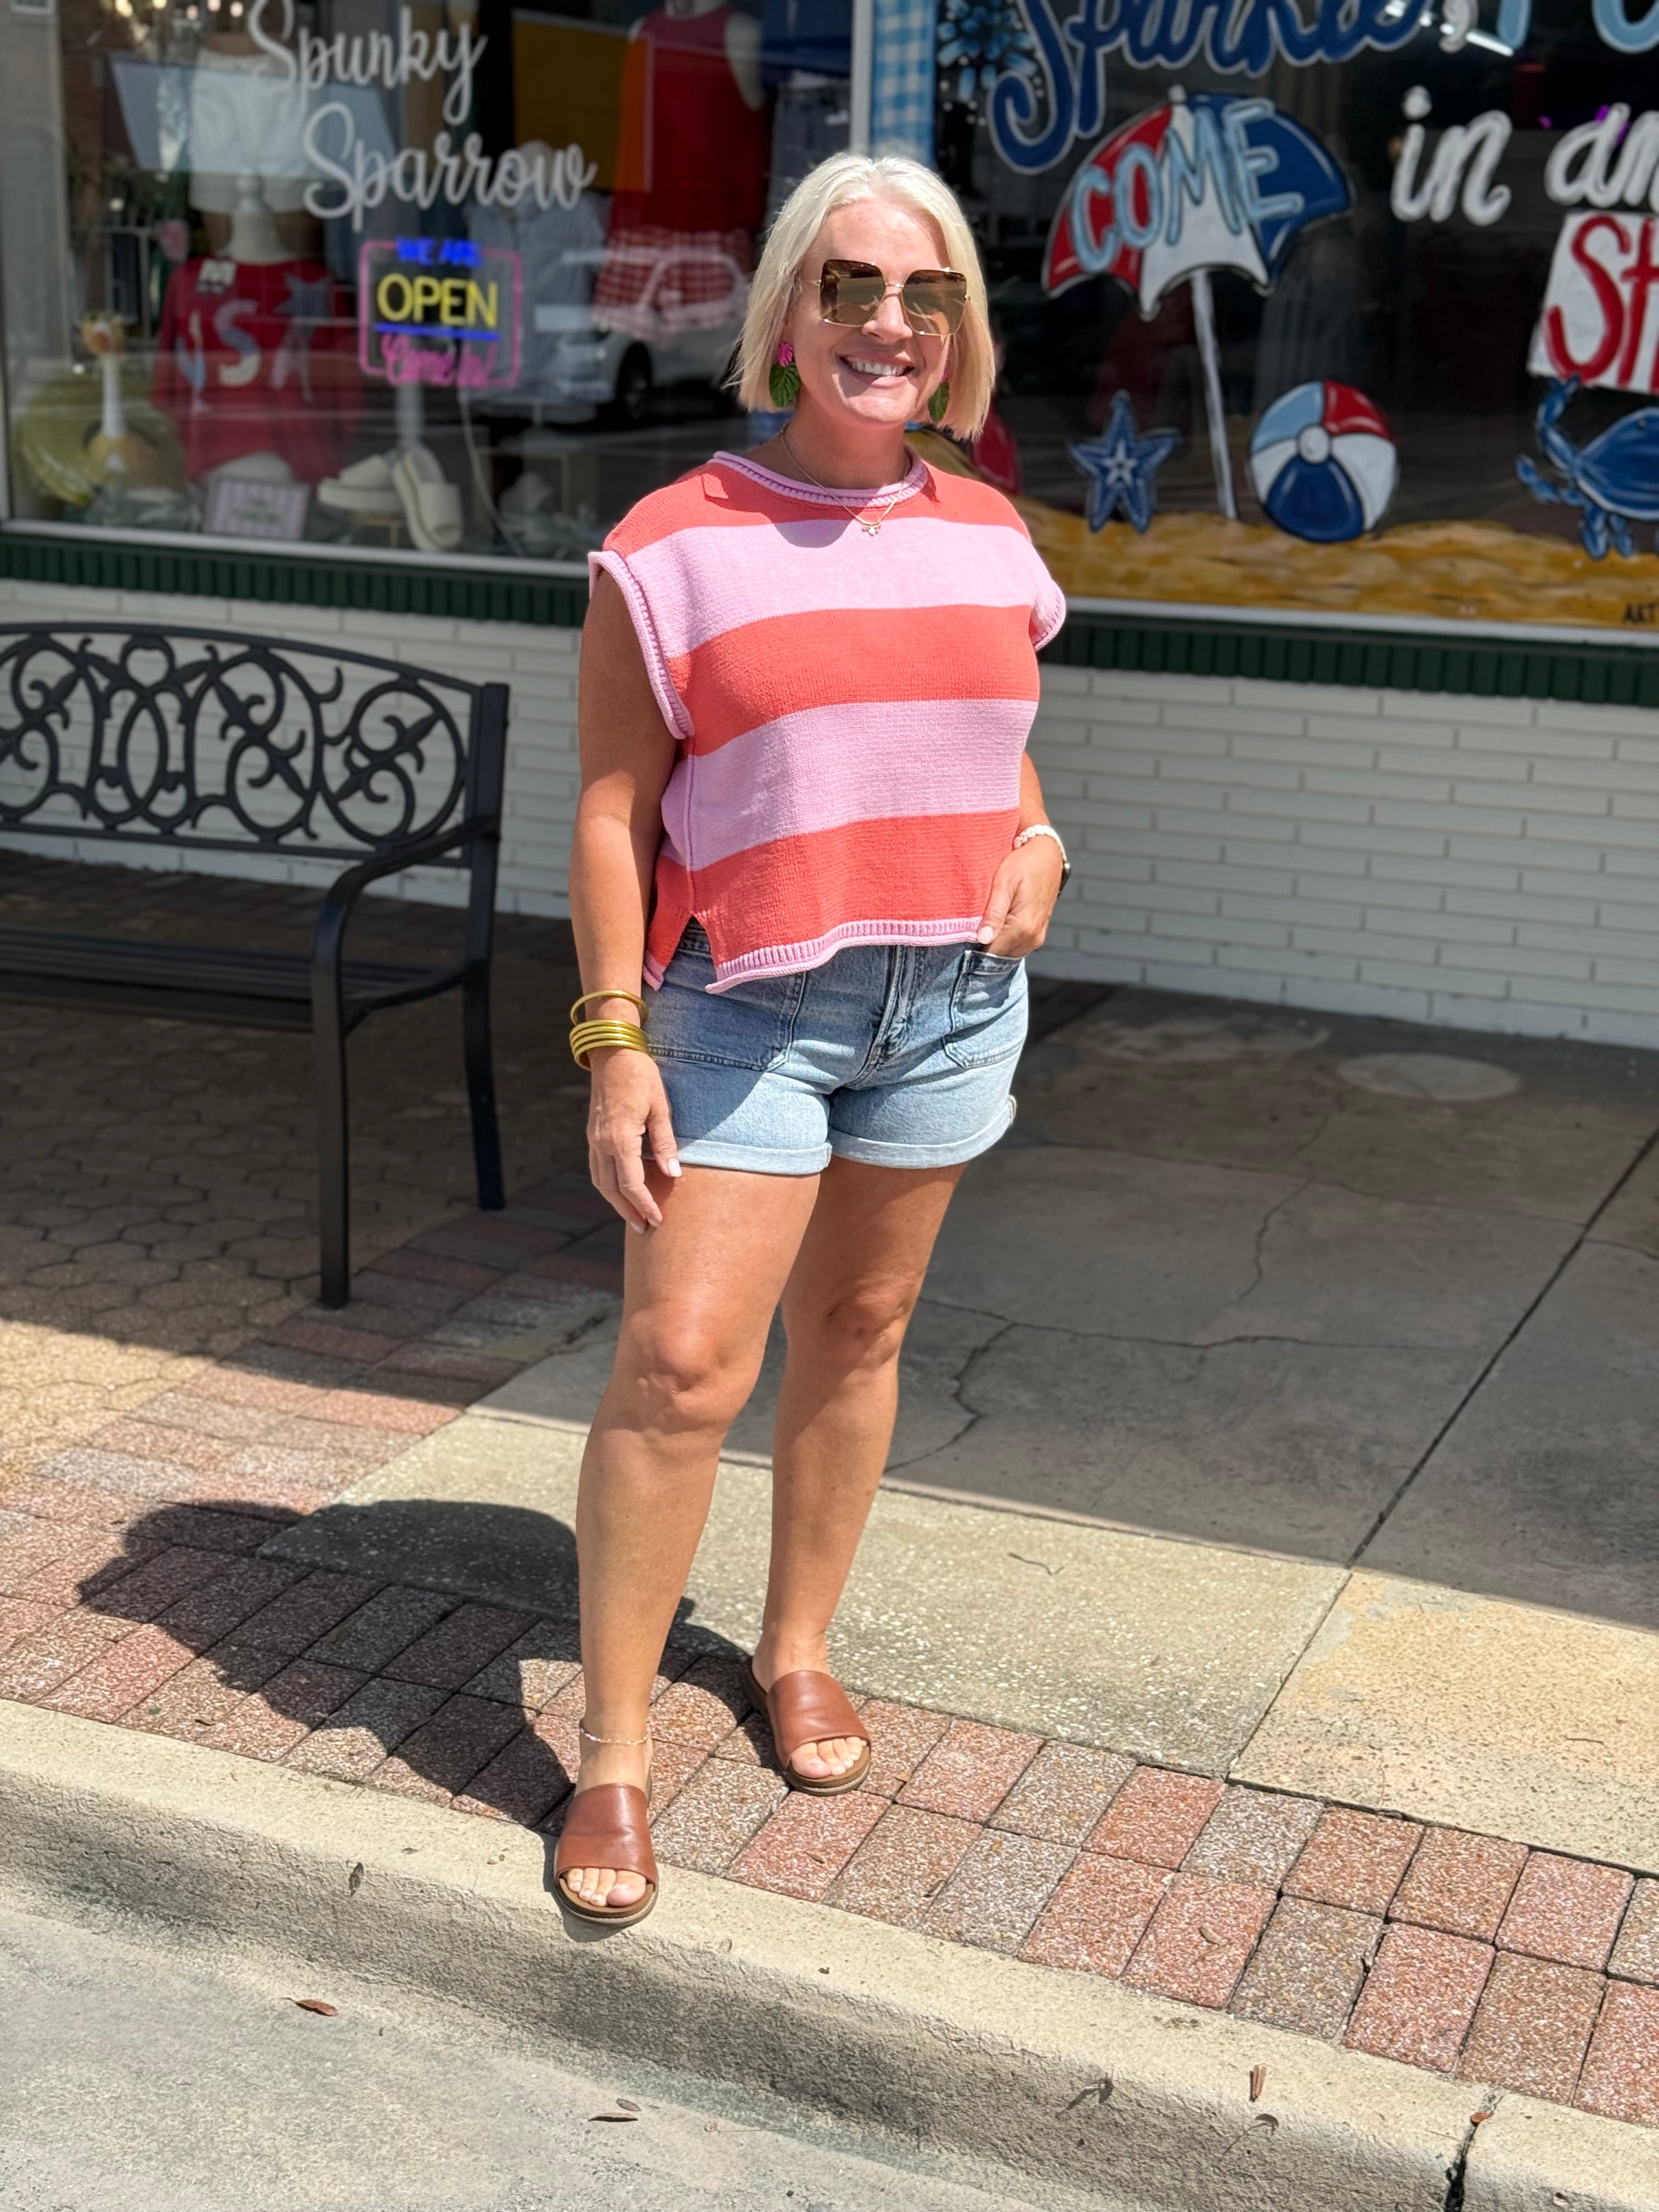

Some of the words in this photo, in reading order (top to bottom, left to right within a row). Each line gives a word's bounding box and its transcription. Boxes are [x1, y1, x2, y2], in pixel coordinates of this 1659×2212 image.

[248, 0, 487, 126] Spunky
[303, 102, 599, 233] Sparrow
[1071, 98, 1306, 274] COME
[1390, 86, 1513, 225] in
[376, 273, 499, 329] OPEN
